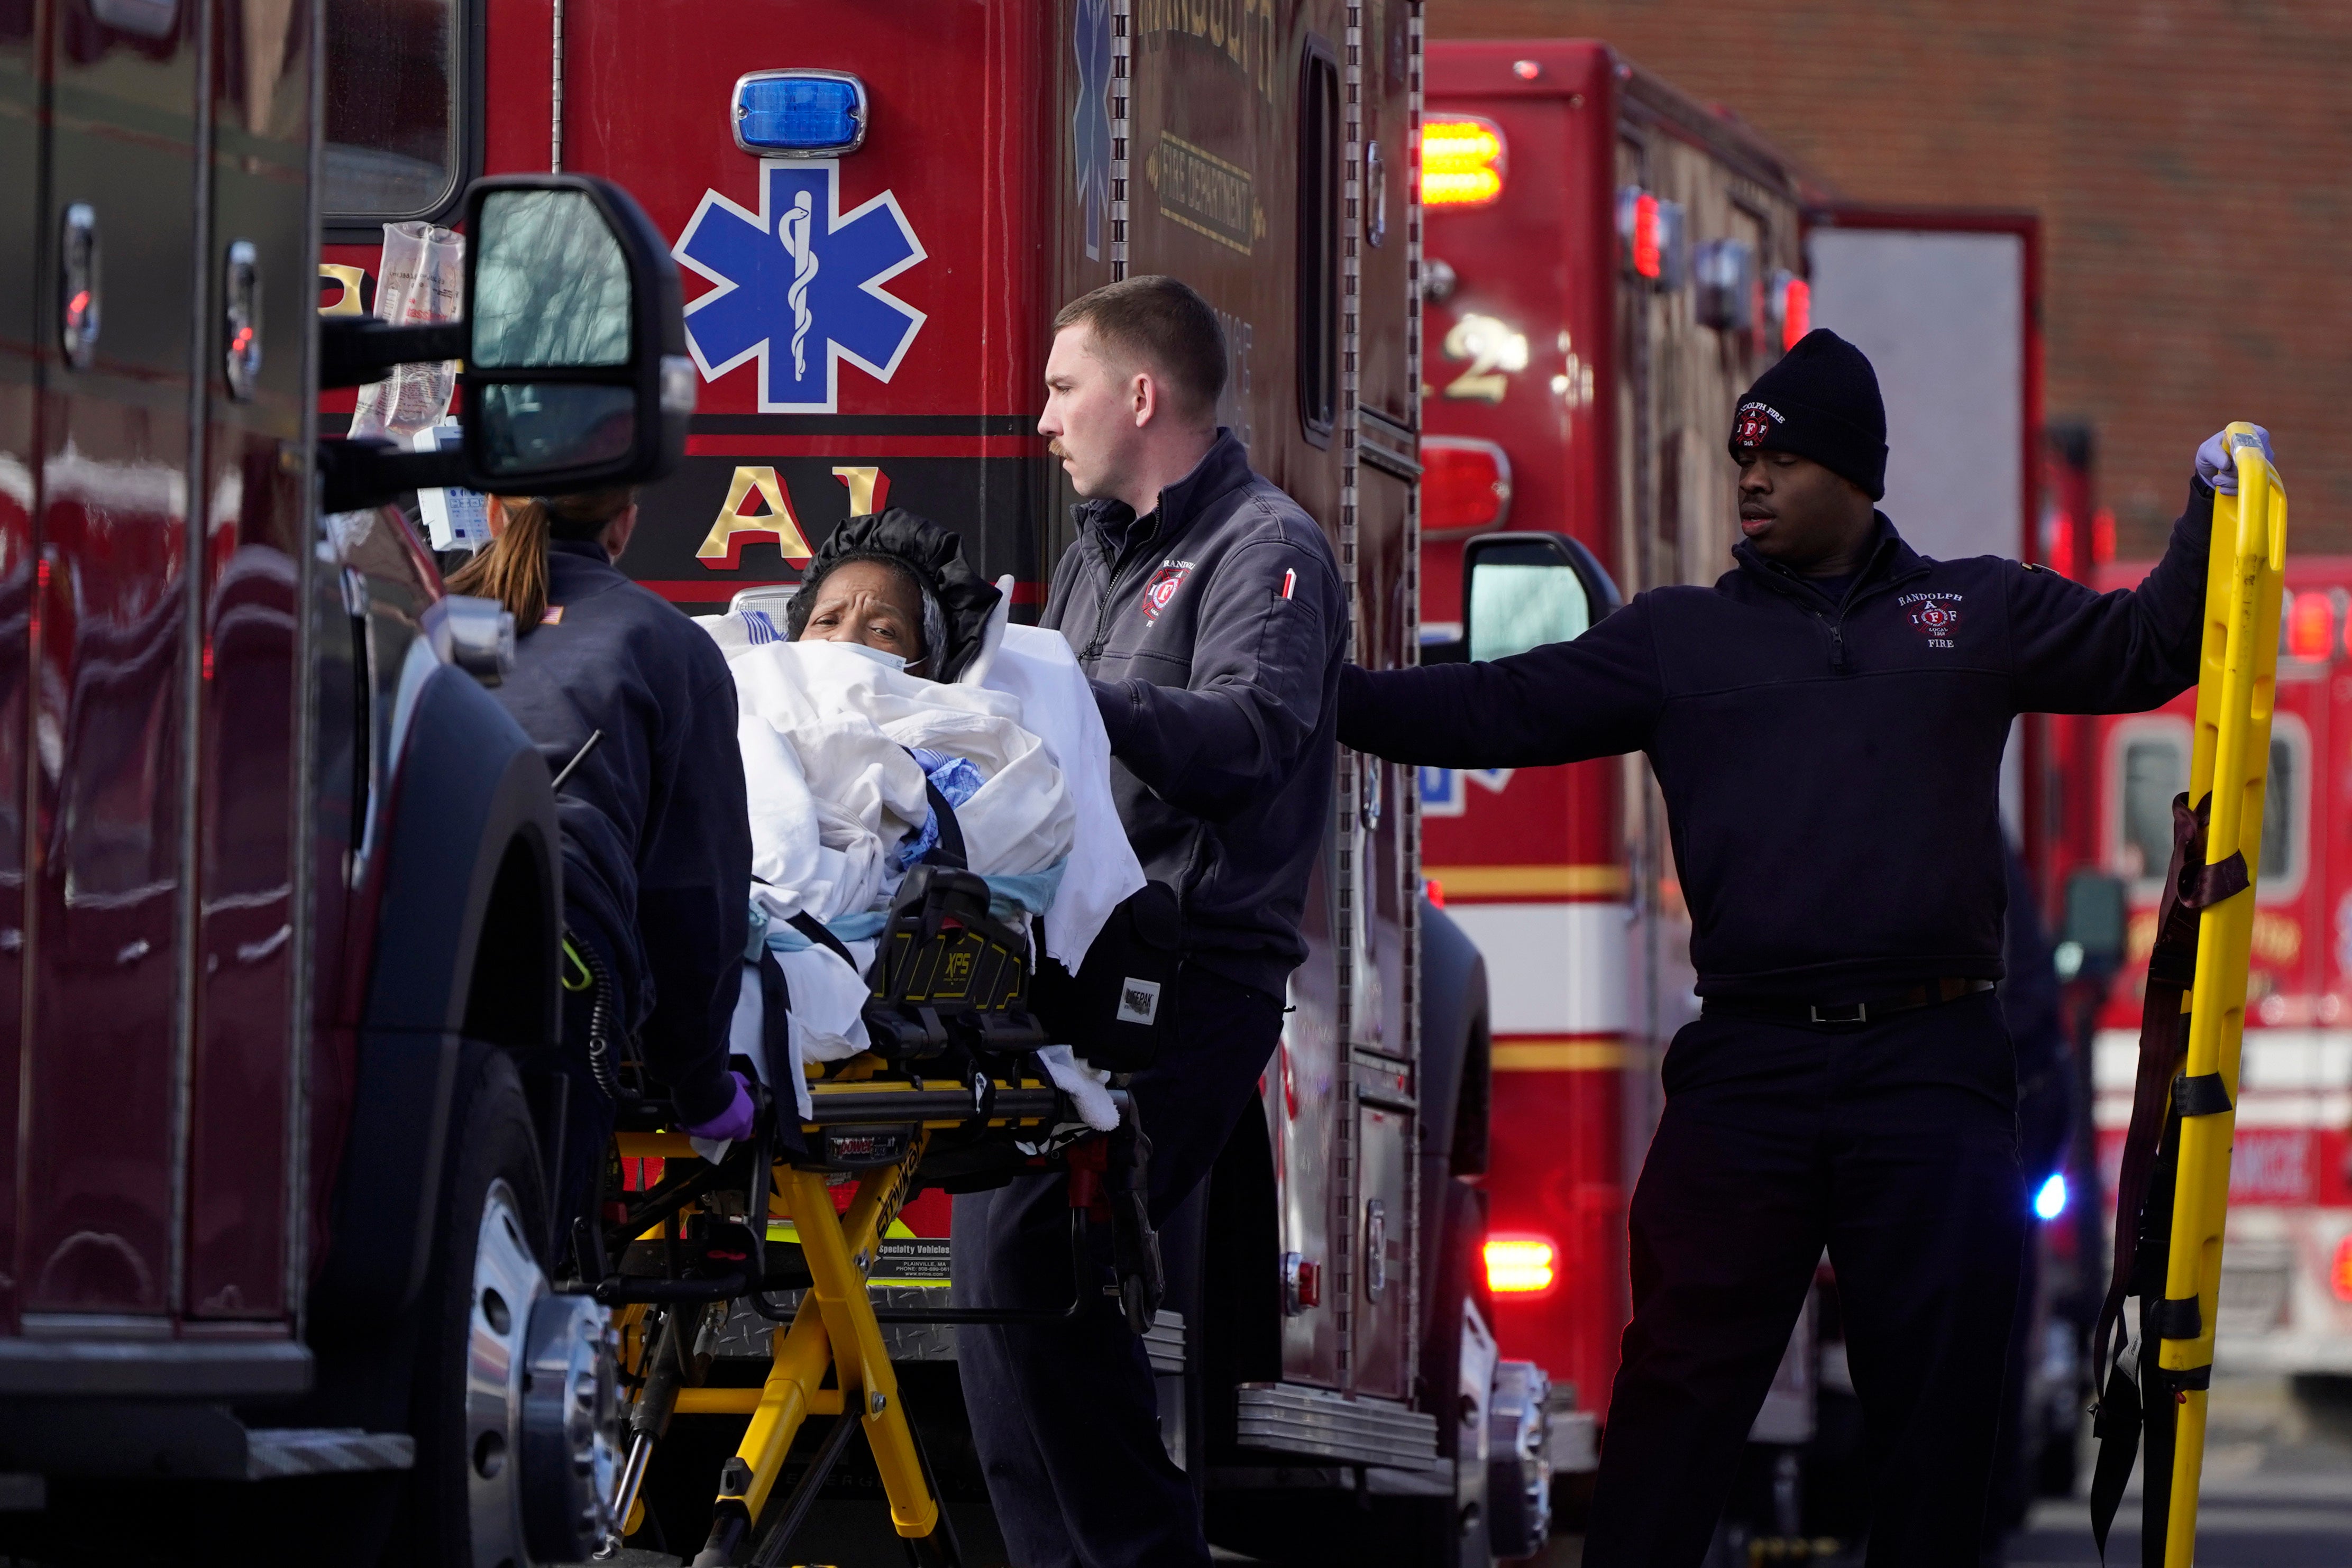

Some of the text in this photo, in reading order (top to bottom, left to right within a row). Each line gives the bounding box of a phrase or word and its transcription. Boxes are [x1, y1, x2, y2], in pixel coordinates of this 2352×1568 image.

[1766, 407, 1786, 424] FIRE
[1745, 423, 1756, 434] F
[1759, 425, 1767, 434] F
[1157, 584, 1174, 601] F
[1898, 593, 1963, 606] RANDOLPH
[1924, 600, 1937, 609] A
[1929, 612, 1939, 622] F
[1948, 610, 1957, 621] F
[1928, 639, 1954, 648] FIRE
[945, 952, 971, 978] XPS
[878, 1245, 915, 1255] Specialty
